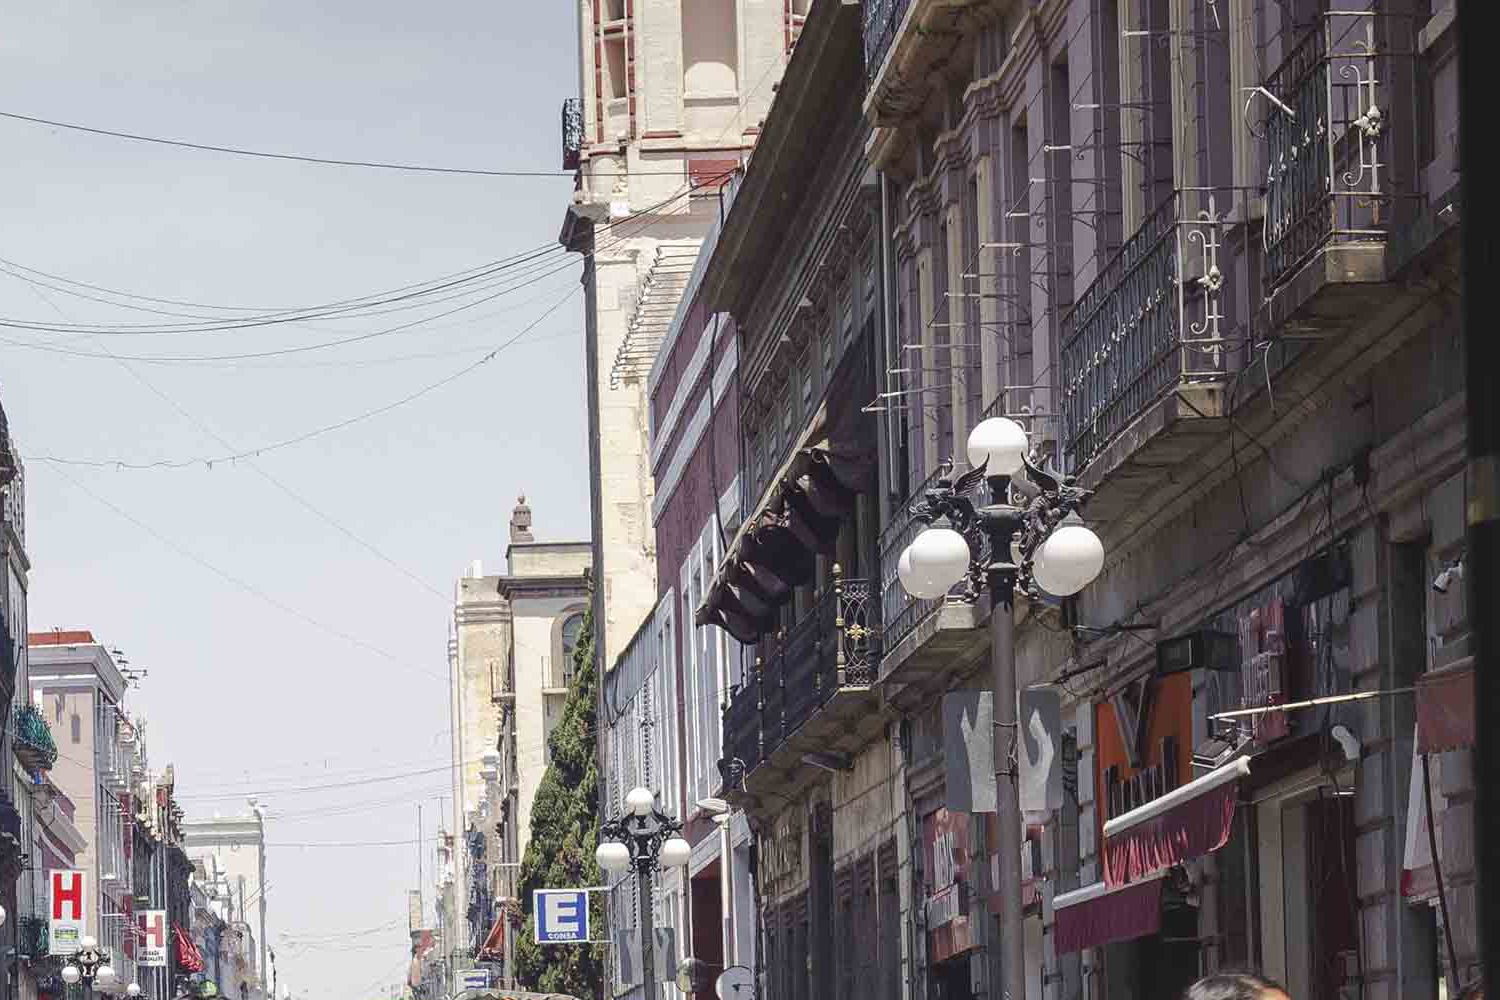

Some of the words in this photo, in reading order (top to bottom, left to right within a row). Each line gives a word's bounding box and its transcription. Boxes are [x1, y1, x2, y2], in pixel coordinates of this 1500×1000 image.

[53, 873, 82, 920] H
[545, 894, 579, 933] E
[138, 914, 163, 948] H
